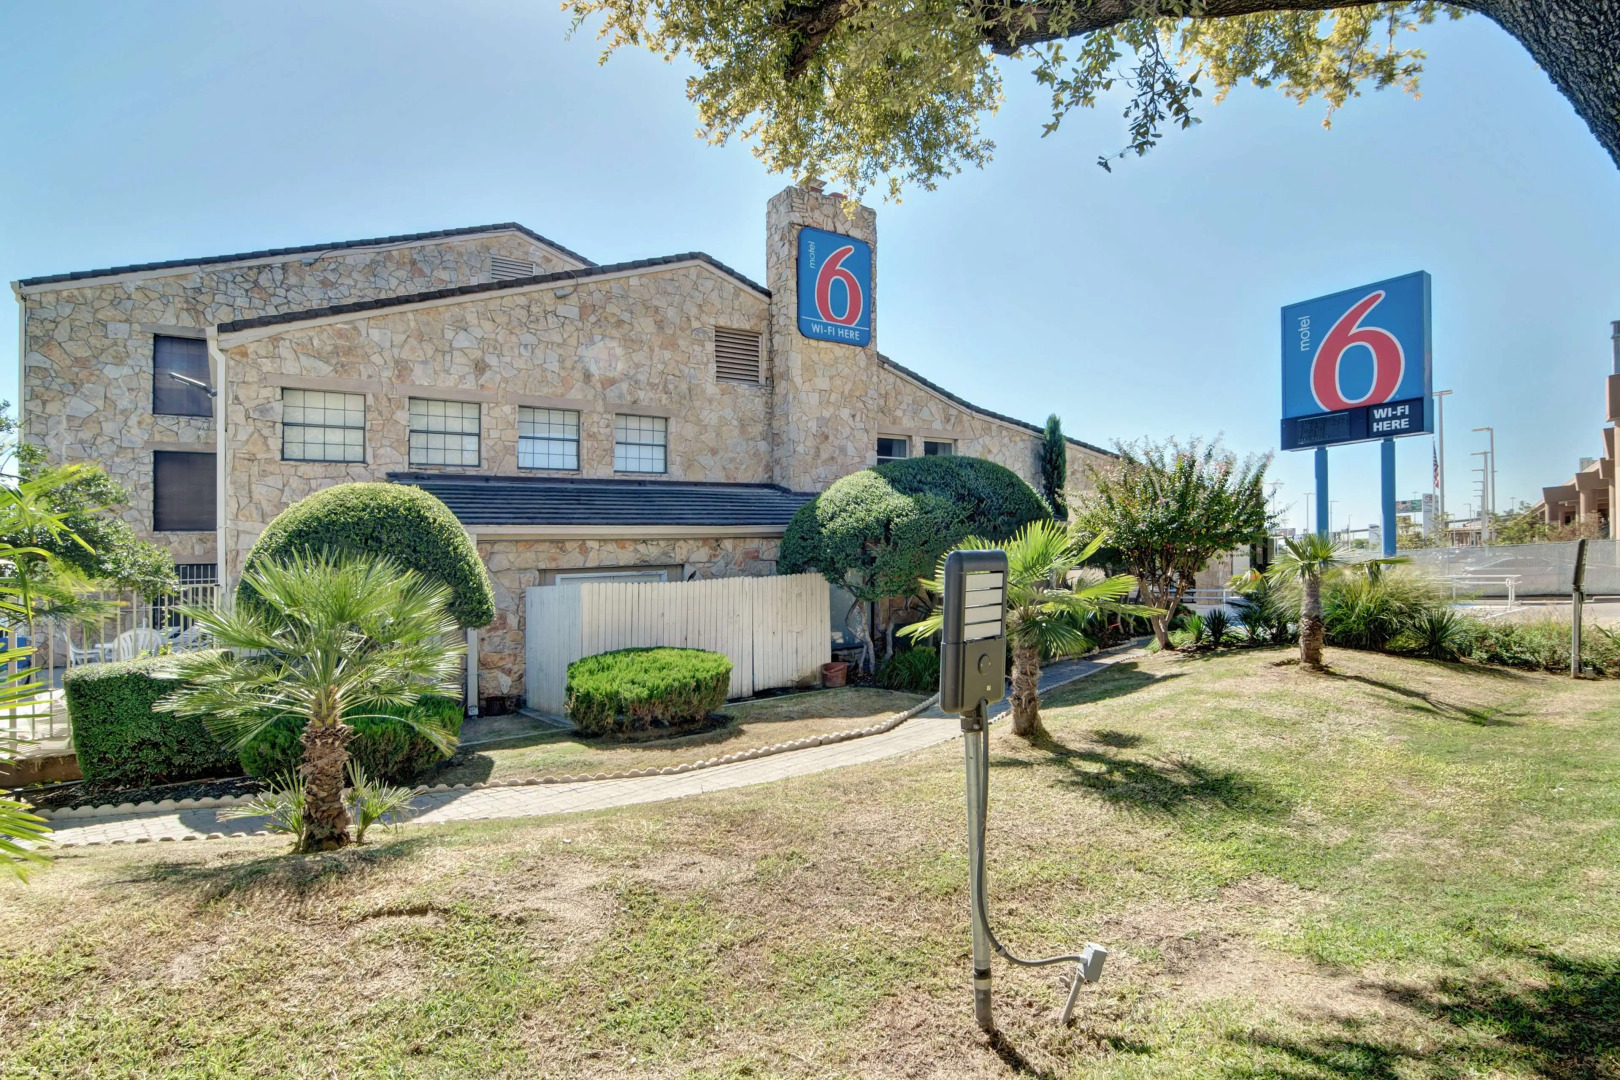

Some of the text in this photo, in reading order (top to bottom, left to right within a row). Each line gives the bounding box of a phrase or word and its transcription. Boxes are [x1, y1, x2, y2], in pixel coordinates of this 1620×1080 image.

[815, 245, 863, 327] 6
[811, 323, 860, 340] WI-FI HERE
[1298, 315, 1310, 351] motel
[1310, 289, 1405, 412] 6
[1373, 405, 1409, 419] WI-FI
[1373, 418, 1409, 432] HERE
